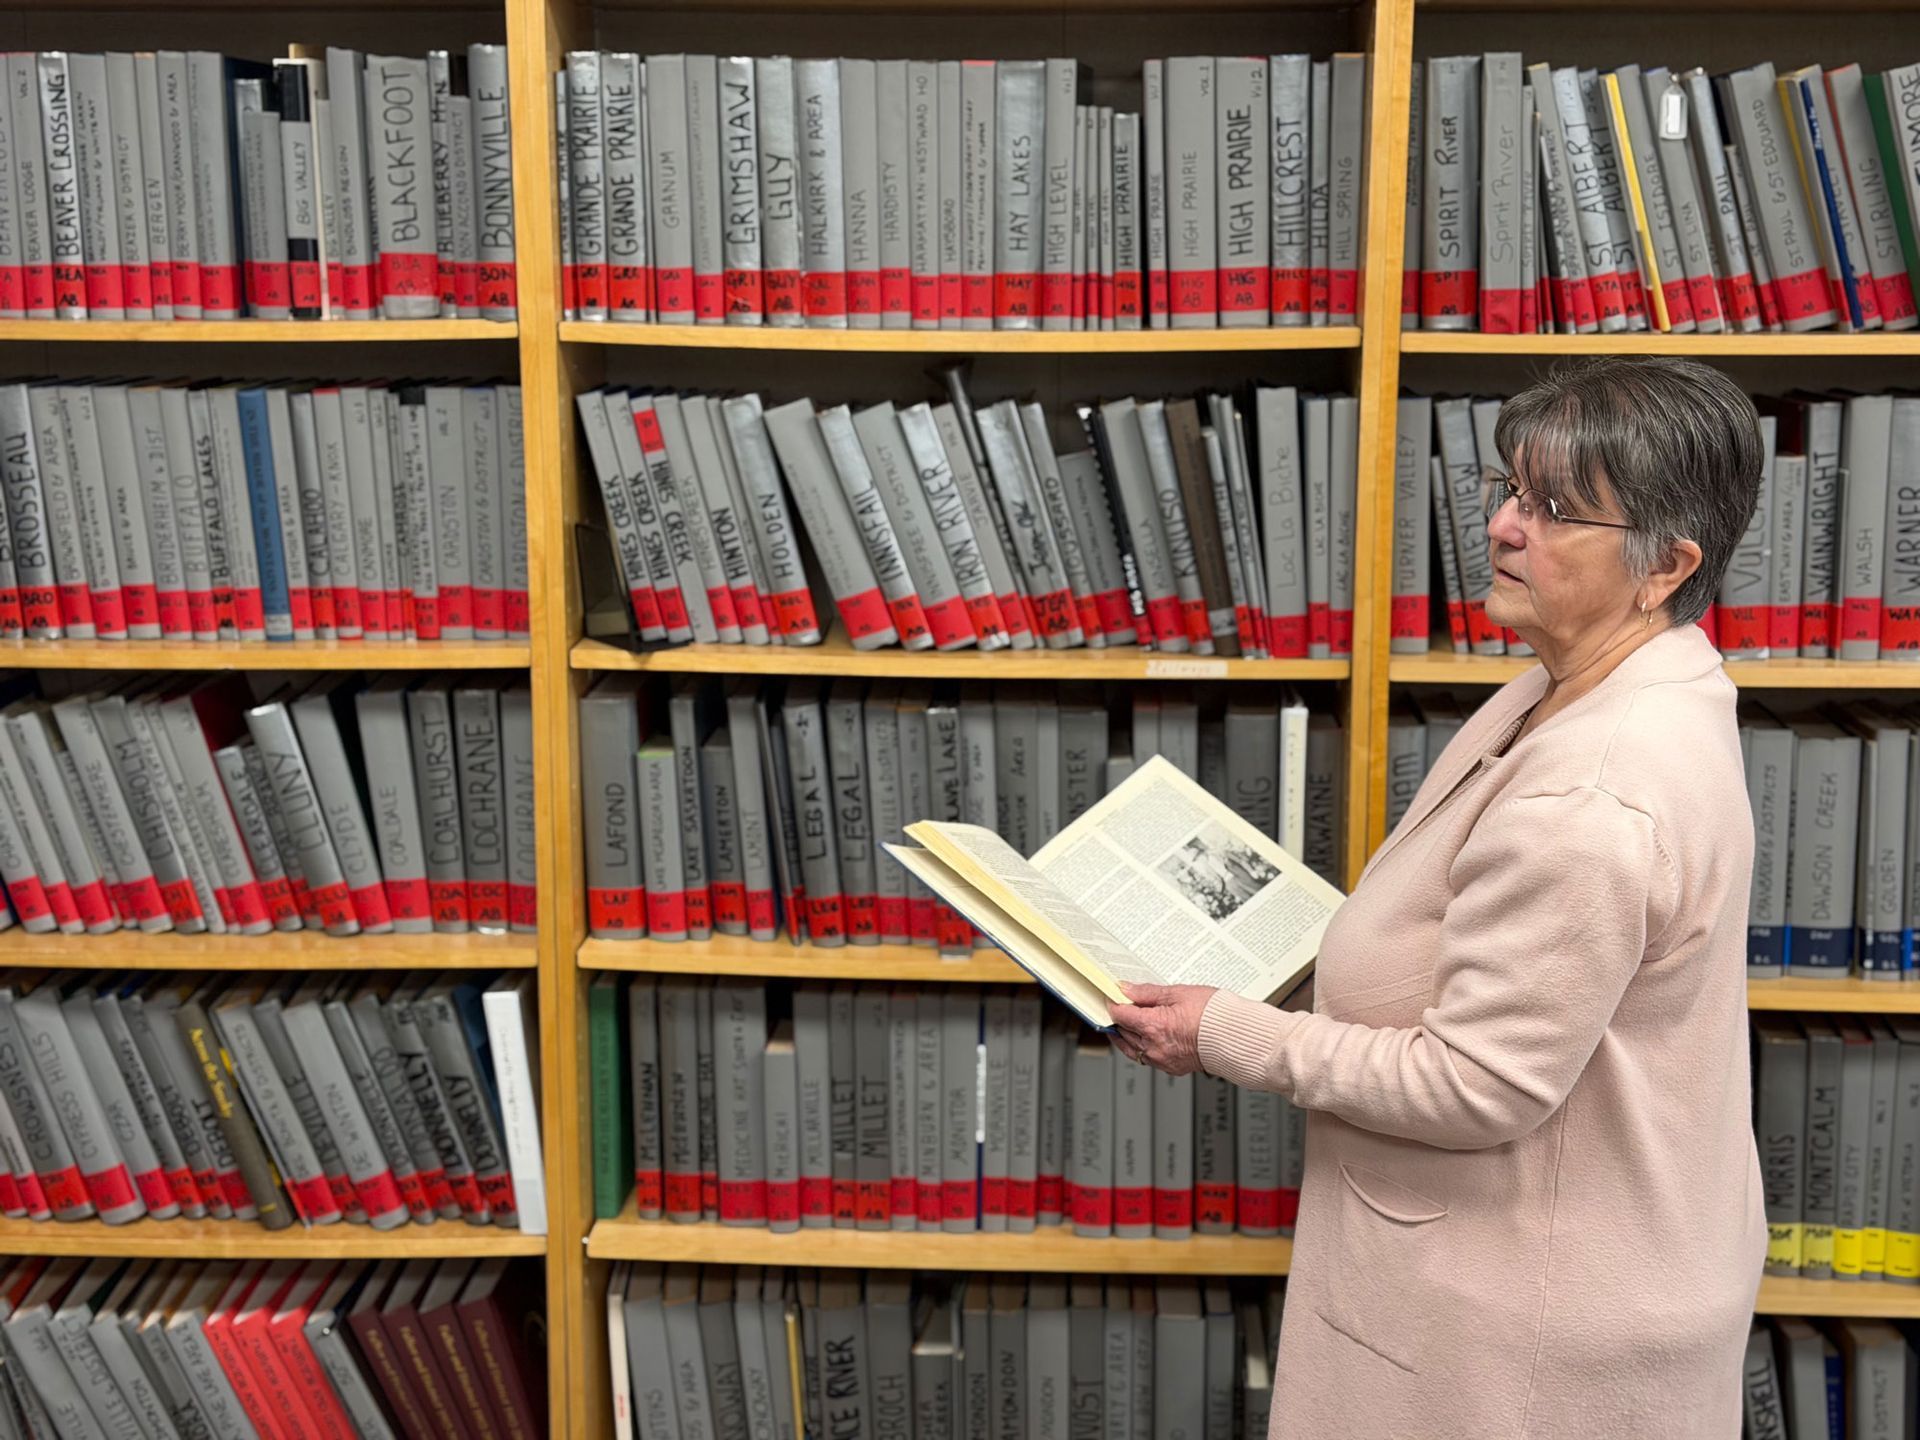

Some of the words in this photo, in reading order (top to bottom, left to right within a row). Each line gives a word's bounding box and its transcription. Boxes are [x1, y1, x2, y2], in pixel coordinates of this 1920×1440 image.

[48, 74, 72, 170] CROSSING
[381, 65, 420, 242] BLACKFOOT
[572, 85, 600, 161] PRAIRIE
[607, 84, 635, 161] PRAIRIE
[807, 94, 822, 142] AREA
[1227, 106, 1253, 190] PRAIRIE
[1434, 115, 1458, 165] RIVER
[479, 86, 512, 248] BONNYVILLE
[660, 151, 679, 229] GRANUM
[726, 82, 755, 244] GRIMSHAW
[1011, 135, 1031, 196] LAKES
[1114, 145, 1128, 214] PRAIRIE
[1183, 152, 1197, 209] PRAIRIE
[1276, 117, 1306, 247] HILLCREST
[1491, 126, 1514, 197] River
[1715, 167, 1735, 216] PAUL
[54, 178, 80, 257] BEAVER
[575, 173, 601, 256] GRANDE
[610, 173, 639, 255] GRANDE
[807, 169, 828, 255] HALKIRK
[852, 190, 867, 263] HANNA
[883, 162, 900, 242] HARDISTY
[1009, 212, 1028, 250] HAY
[1184, 219, 1198, 257] HIGH
[1228, 201, 1254, 256] HIGH
[1311, 183, 1328, 249] HILDA
[1439, 187, 1460, 258] SPIRIT
[1490, 199, 1513, 264] Spirit
[1859, 158, 1897, 259] STIRLING
[55, 267, 84, 281] BEA
[480, 268, 514, 281] BON
[1117, 225, 1132, 266] HIGH
[59, 294, 79, 306] AB
[196, 434, 220, 489] LAKES
[628, 471, 656, 525] CREEK
[921, 460, 965, 532] RIVER
[6, 432, 46, 569] BROSSEAU
[604, 475, 632, 529] CREEK
[651, 460, 676, 504] HINES
[664, 511, 694, 565] CREEK
[758, 493, 794, 578] HOLDEN
[1807, 451, 1837, 596] WAINWRIGHT
[618, 532, 645, 581] HINES
[644, 531, 671, 581] HINES
[713, 507, 748, 580] HINTON
[950, 538, 987, 587] IRON
[1855, 528, 1873, 588] WALSH
[22, 593, 53, 605] BRO
[266, 751, 326, 850] CLUNY
[465, 719, 500, 866] COCHRANE
[605, 782, 628, 868] LAFOND
[714, 785, 734, 873] LAMERTON
[799, 766, 828, 861] LEGAL
[837, 762, 866, 862] LEGAL
[1816, 771, 1838, 829] CREEK
[330, 803, 367, 874] CLYDE
[687, 847, 702, 881] LAKE
[1812, 844, 1833, 920] DAWSON
[1880, 849, 1895, 914] GOLDEN
[33, 1031, 65, 1084] HILLS
[400, 1052, 463, 1167] DONNELLY
[861, 1076, 888, 1159] MILLET
[1767, 1133, 1795, 1208] MORRIS
[1808, 1087, 1836, 1211] MONTCALM
